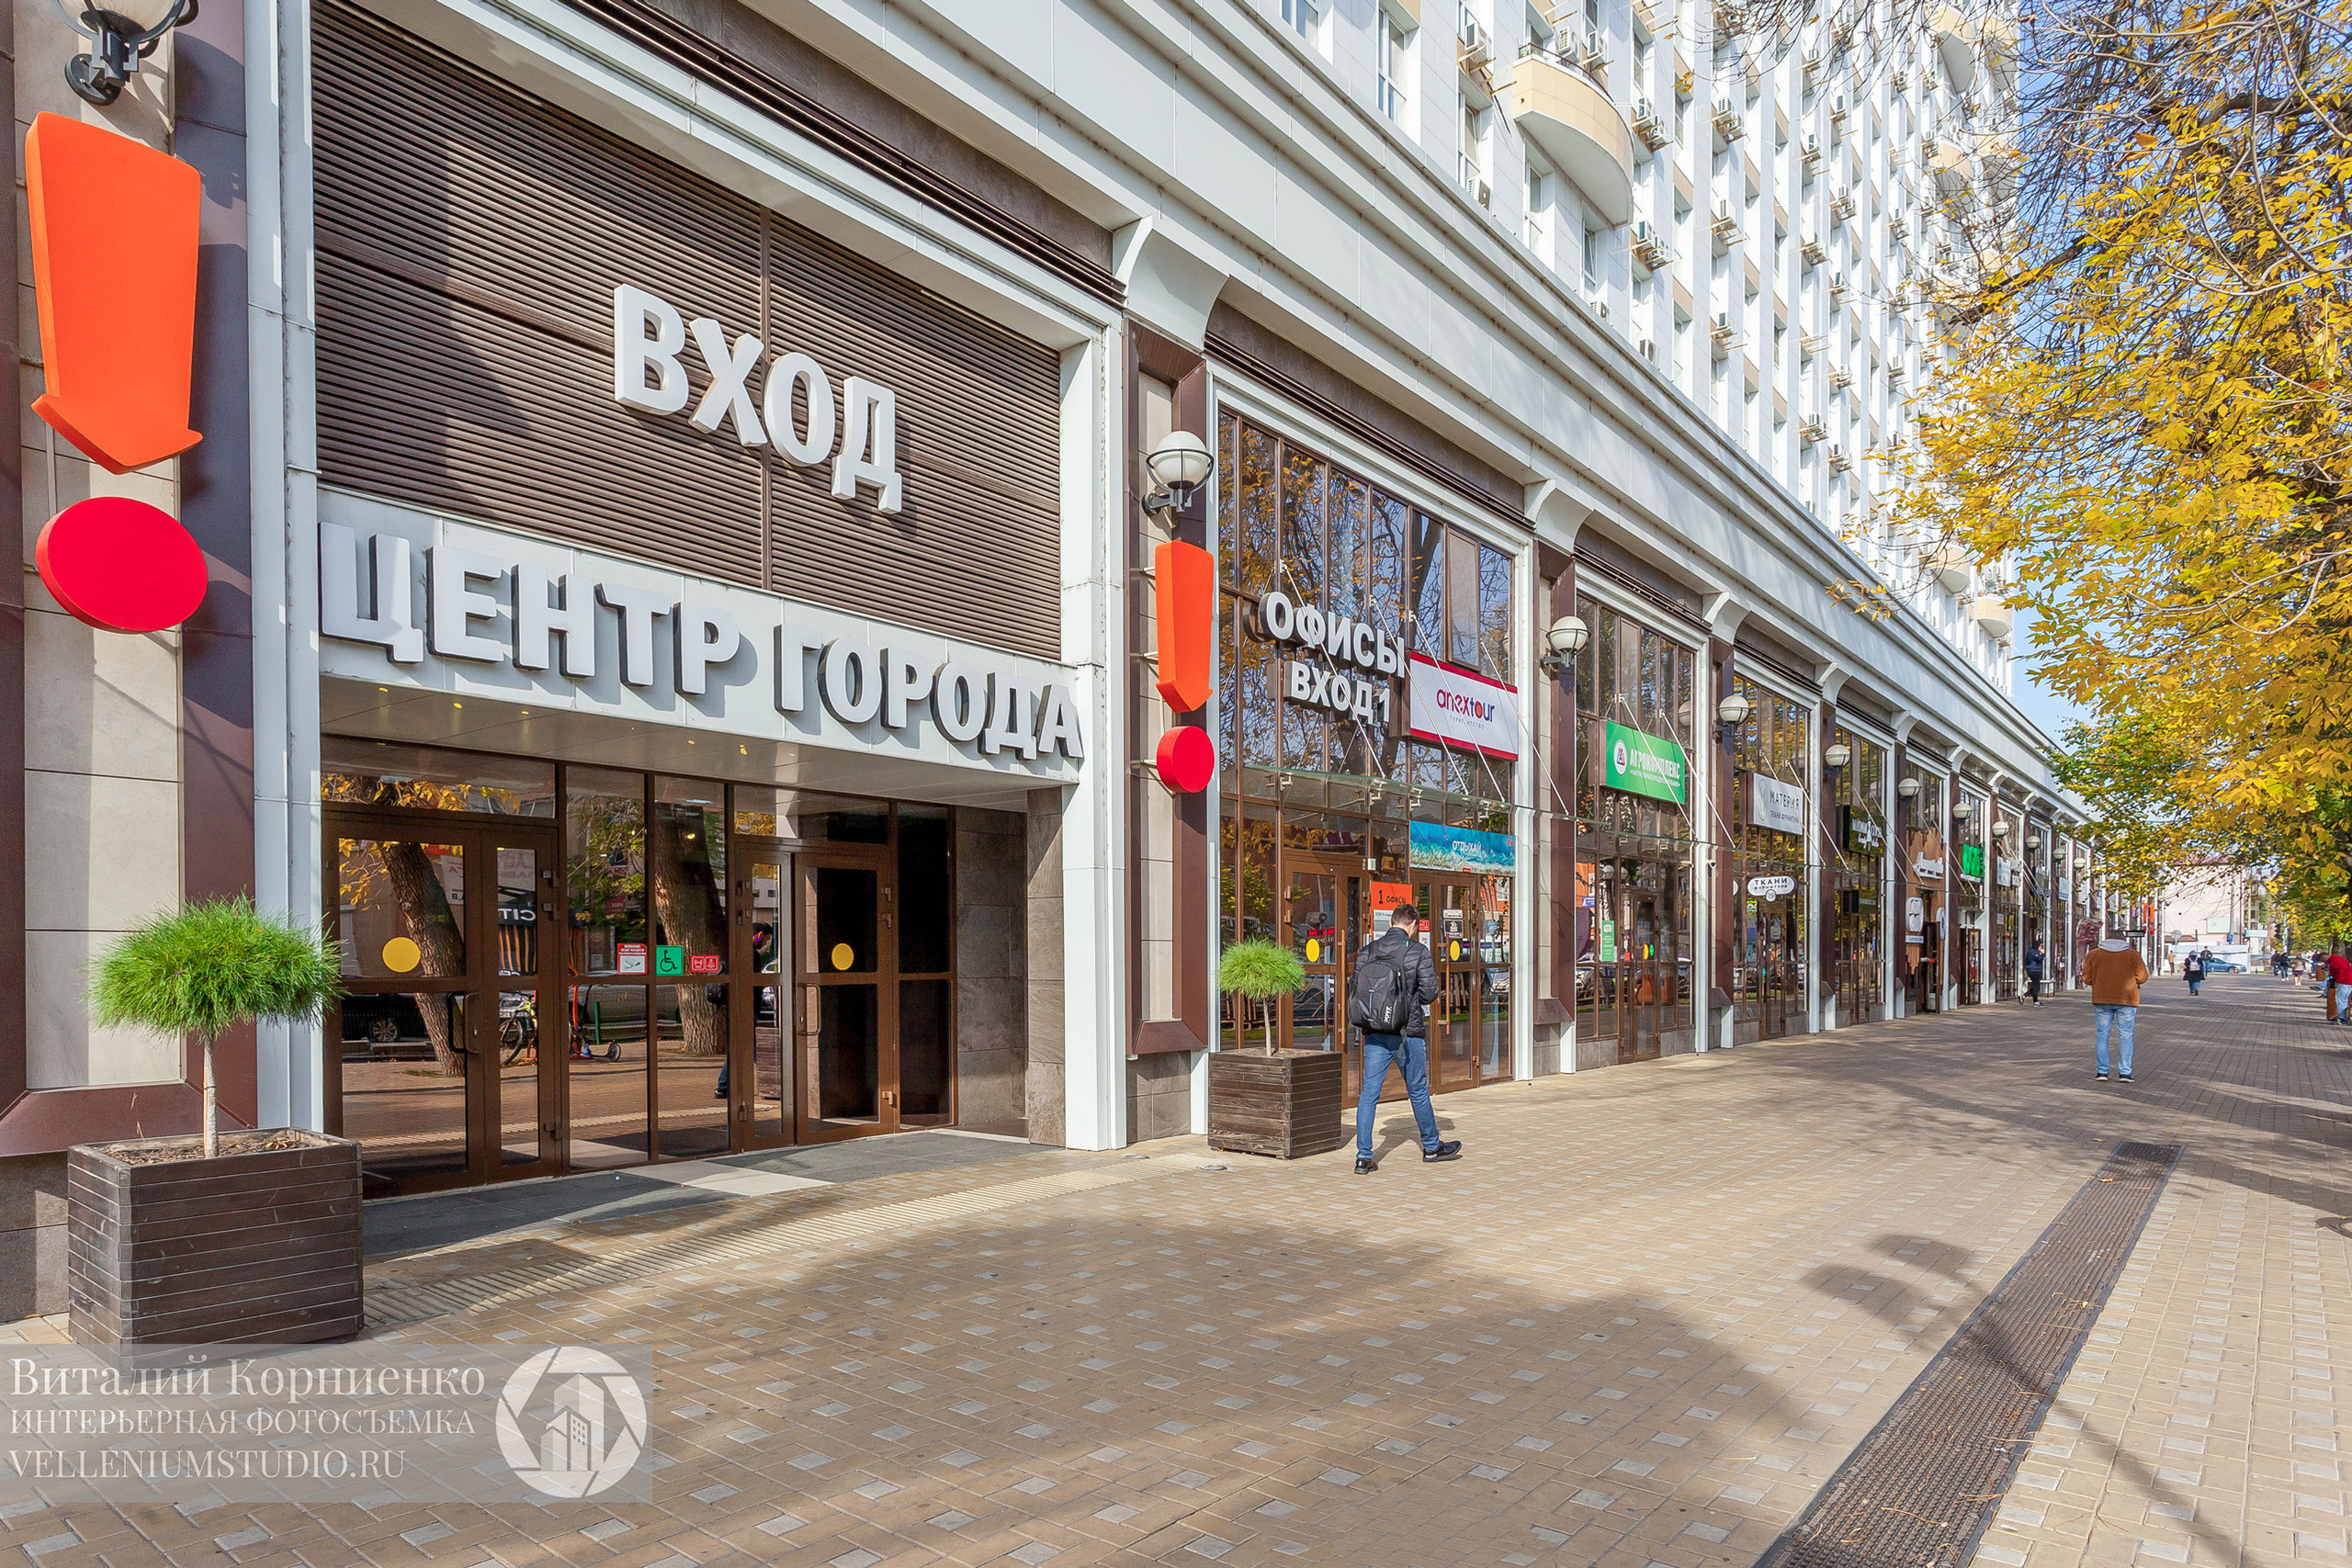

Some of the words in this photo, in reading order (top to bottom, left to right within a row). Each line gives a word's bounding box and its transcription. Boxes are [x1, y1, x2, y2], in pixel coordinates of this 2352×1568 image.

[614, 283, 902, 514] ВХОД
[319, 521, 741, 696] ЦЕНТР
[775, 623, 1084, 761] ГОРОДА
[1260, 591, 1406, 679] ОФИСЫ
[1283, 660, 1374, 727] ВХОД
[1374, 687, 1391, 723] 1
[1436, 689, 1495, 722] anextour
[1770, 790, 1800, 811] МАТЕРИЯ
